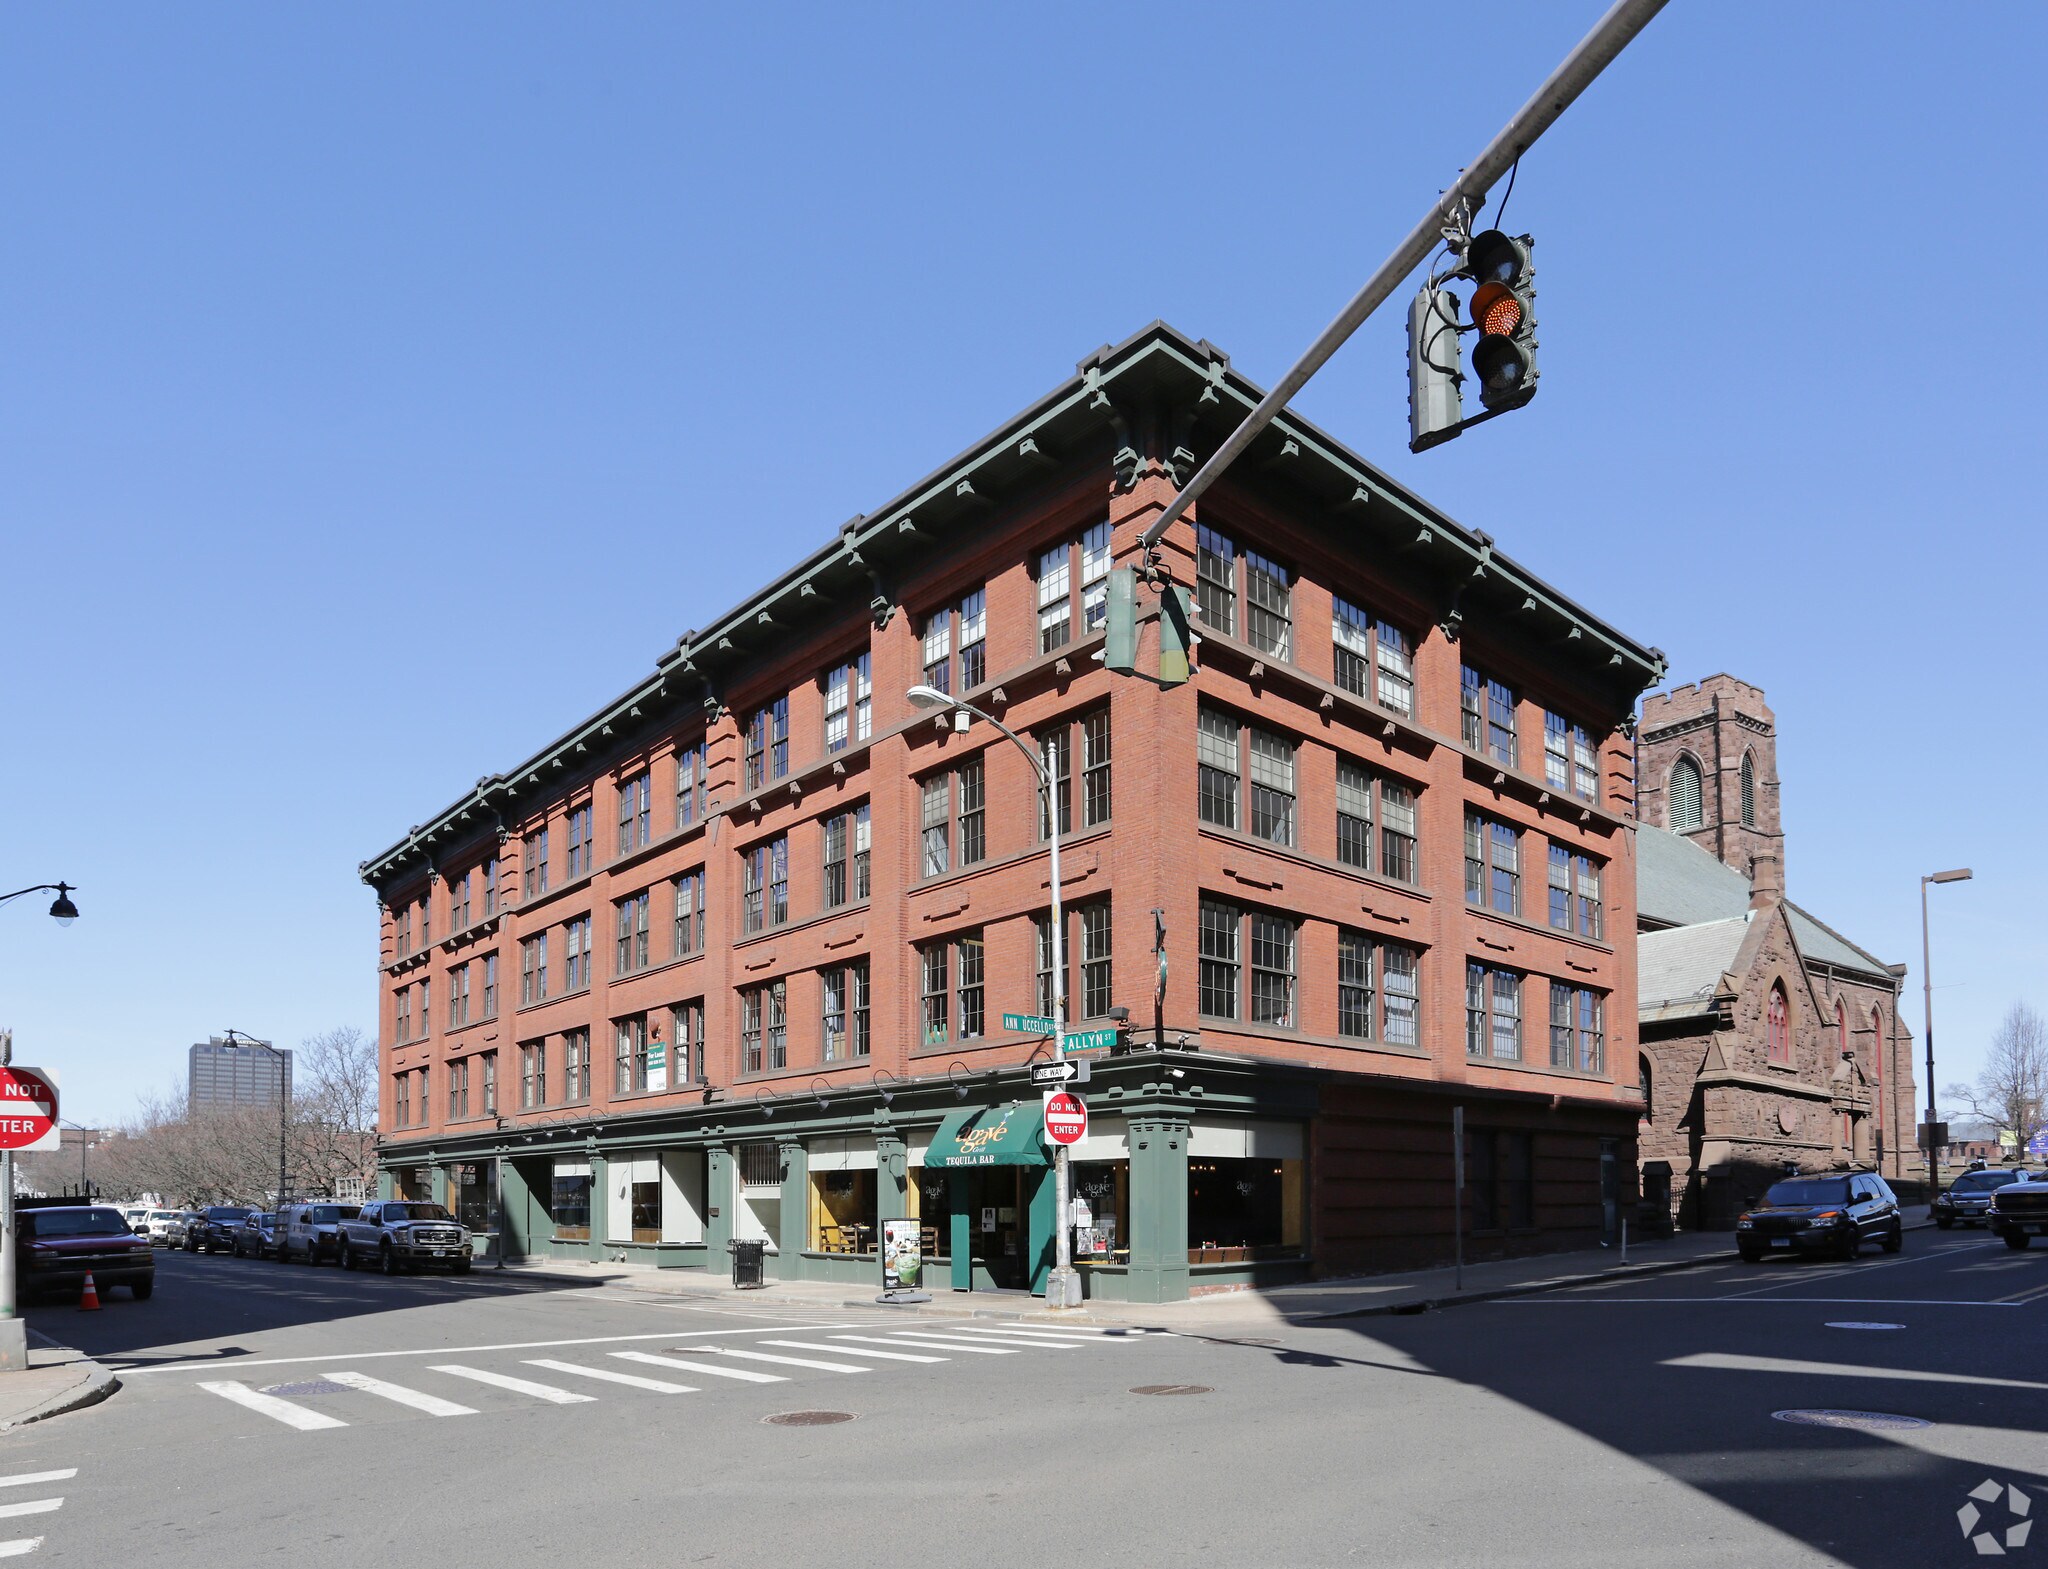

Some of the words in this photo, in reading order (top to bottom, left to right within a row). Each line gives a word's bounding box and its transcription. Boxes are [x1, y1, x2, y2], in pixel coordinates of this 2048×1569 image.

[1005, 1016, 1018, 1029] ANN
[1022, 1018, 1049, 1034] UCCELLO
[1048, 1023, 1055, 1031] ST
[1068, 1033, 1103, 1051] ALLYN
[1104, 1033, 1112, 1041] ST
[1034, 1069, 1048, 1079] ONE
[1049, 1067, 1064, 1077] WAY
[5, 1083, 42, 1097] NOT
[1050, 1102, 1062, 1111] DO
[1065, 1103, 1080, 1112] NOT
[1054, 1125, 1078, 1134] ENTER
[955, 1121, 1008, 1153] agave
[946, 1155, 977, 1166] TEQUILA
[979, 1155, 995, 1164] BAR
[1085, 1182, 1110, 1198] agave
